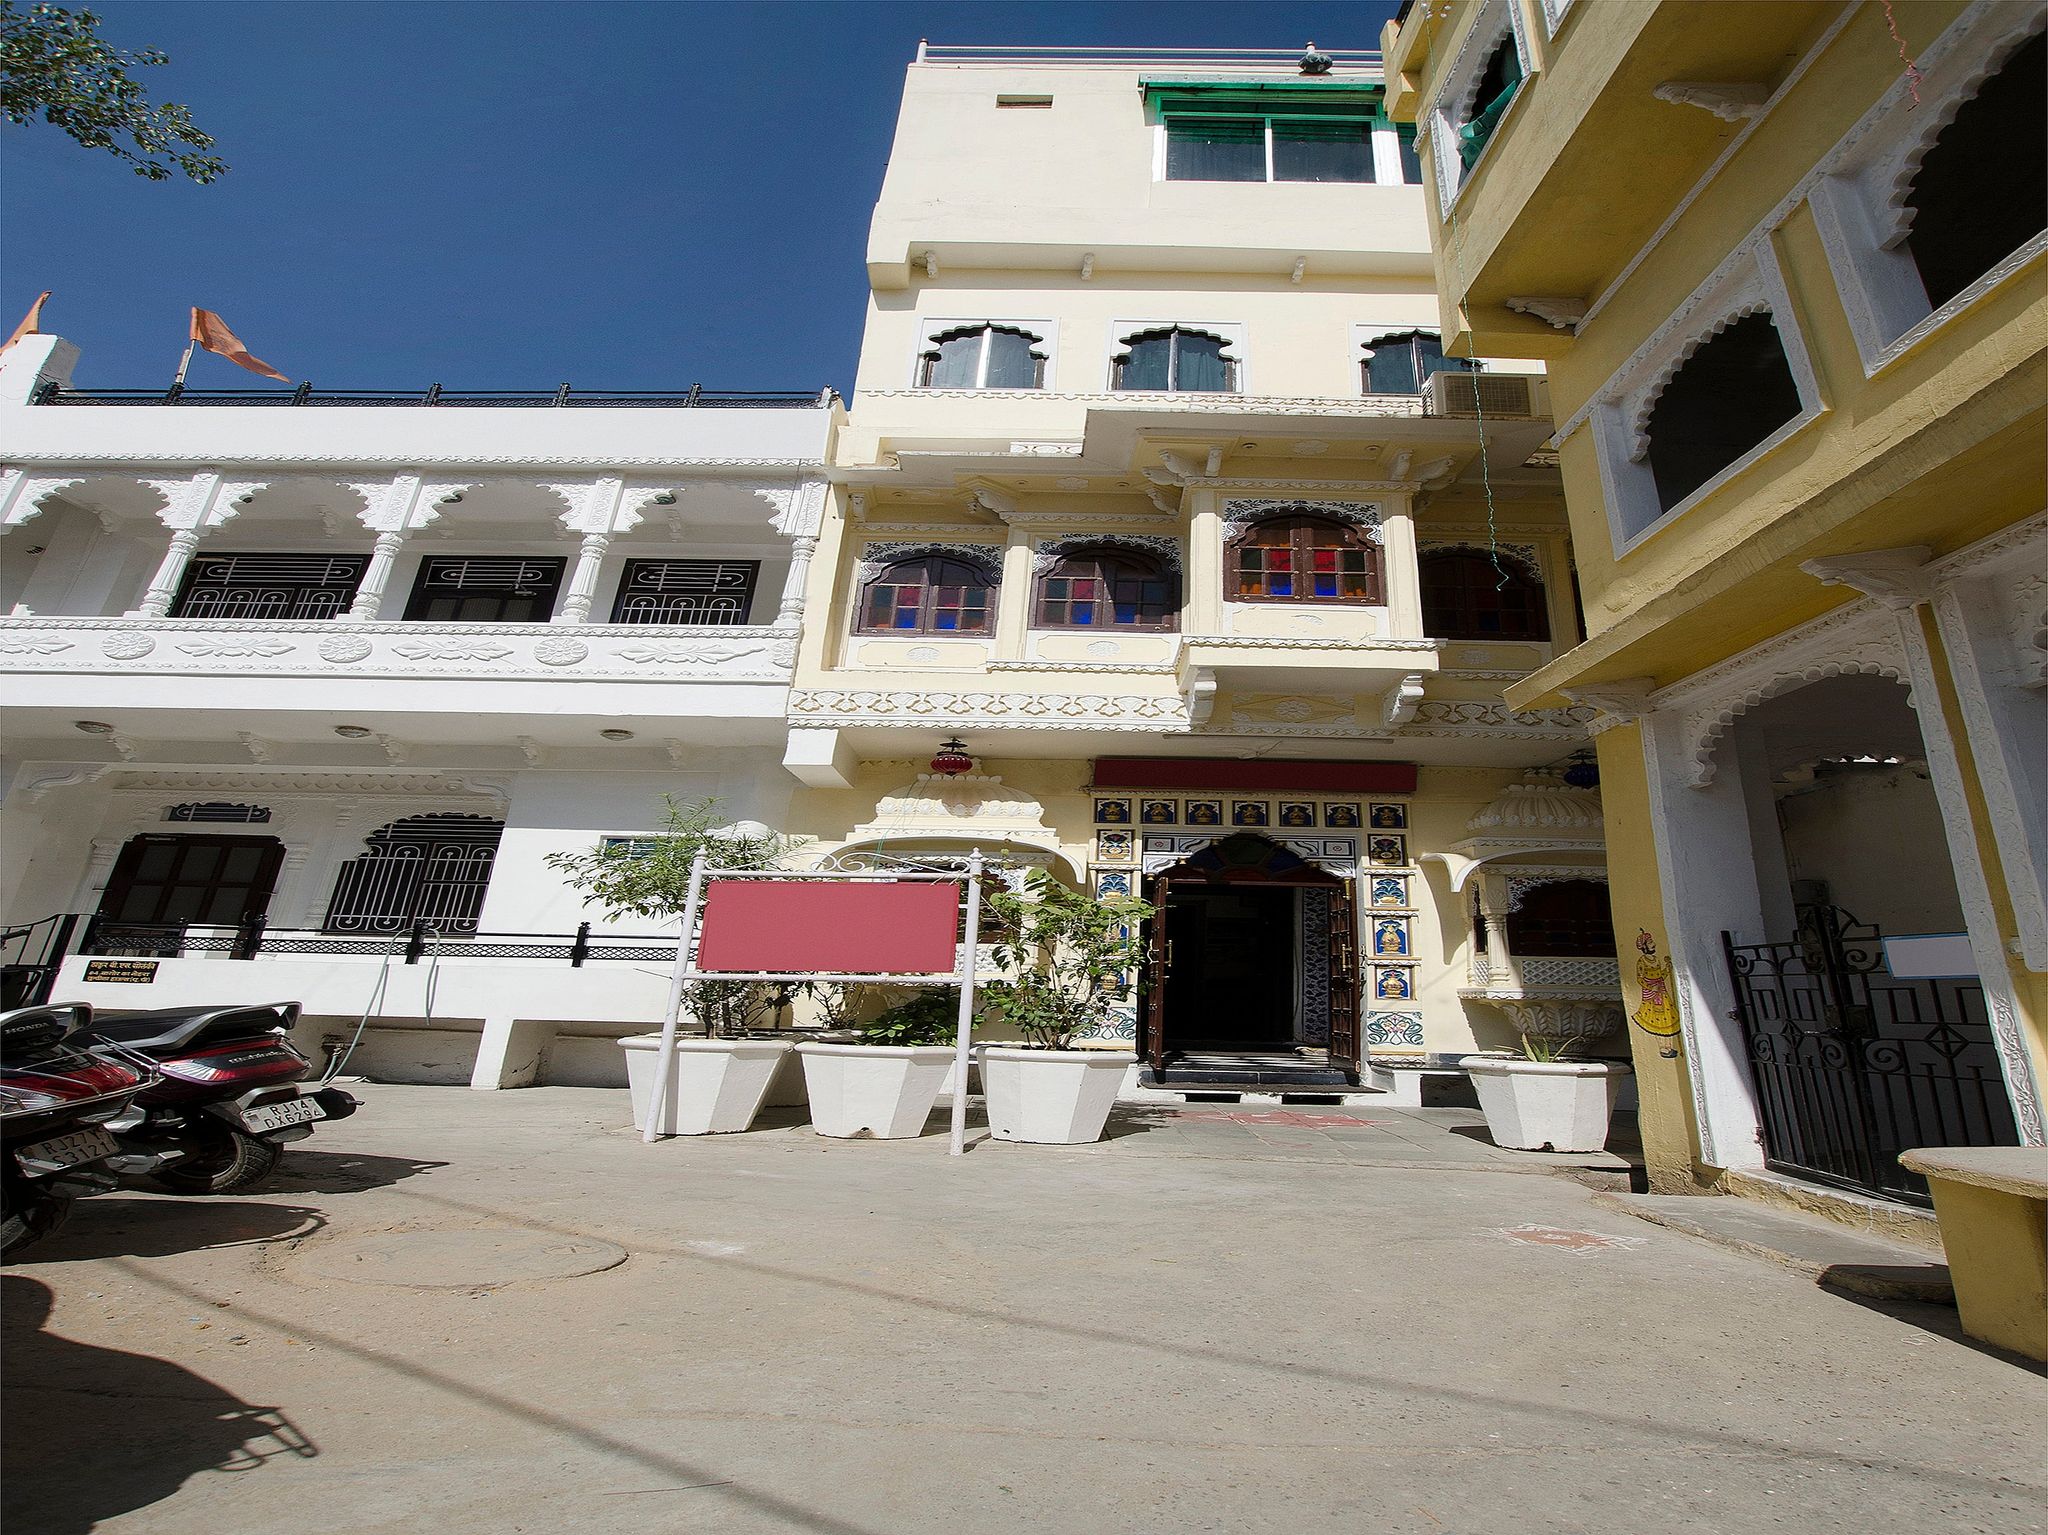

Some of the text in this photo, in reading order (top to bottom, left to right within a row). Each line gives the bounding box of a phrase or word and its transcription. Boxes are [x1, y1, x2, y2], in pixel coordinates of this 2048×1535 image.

[4, 1022, 51, 1035] HONDA
[269, 1100, 309, 1116] RJ14
[264, 1109, 321, 1129] DX6294
